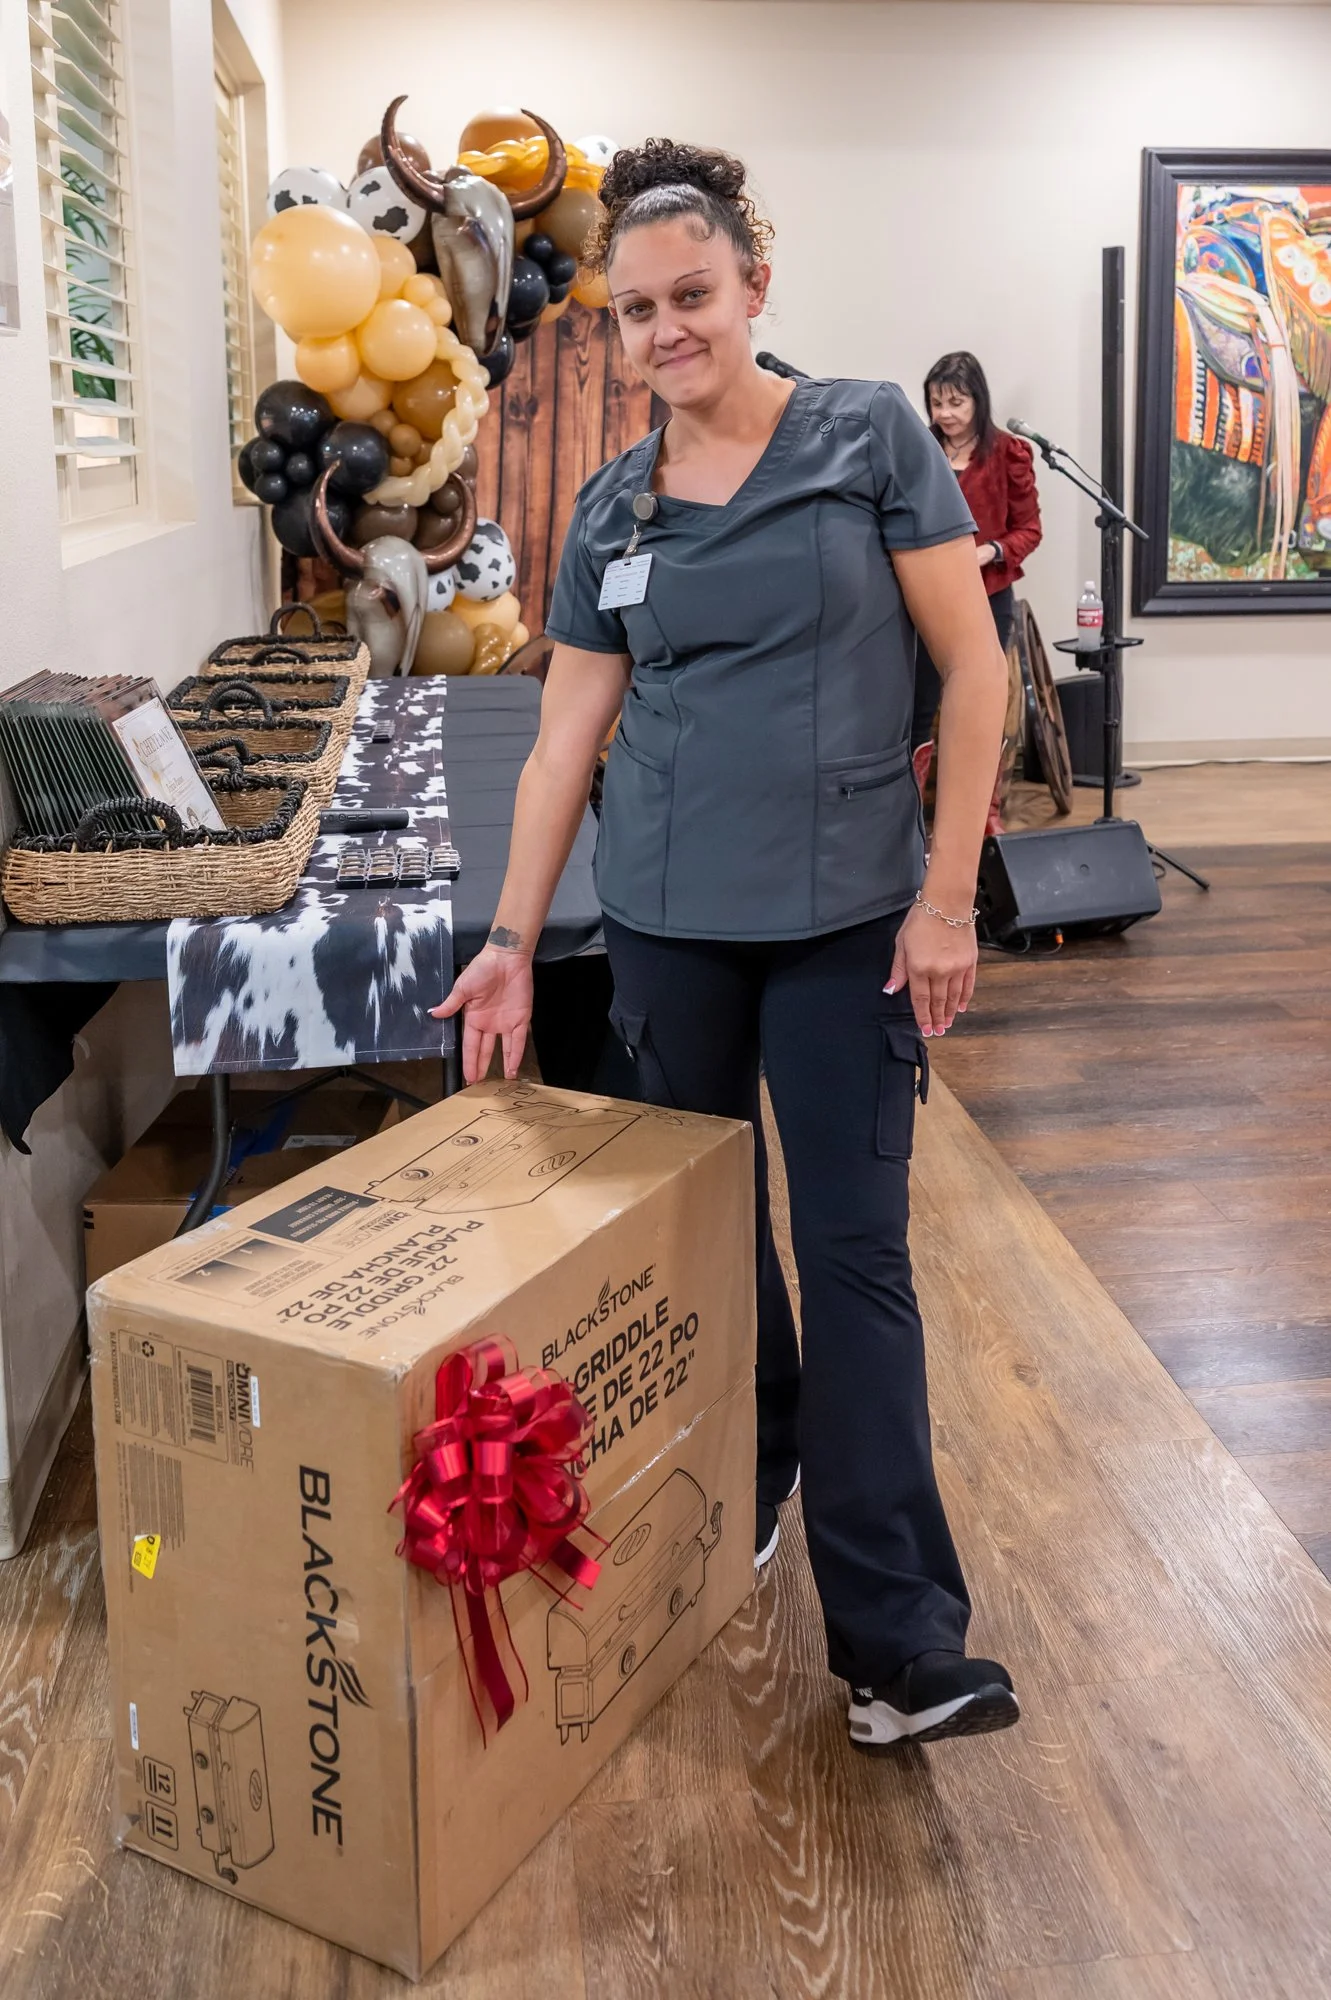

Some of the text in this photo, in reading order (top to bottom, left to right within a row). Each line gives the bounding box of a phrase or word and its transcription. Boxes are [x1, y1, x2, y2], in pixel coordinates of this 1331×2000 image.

[303, 1220, 485, 1324] PLAQUE DE 22 PO
[308, 1281, 348, 1301] DE
[341, 1224, 446, 1280] PLANCHA
[326, 1275, 424, 1331] GRIDDLE
[357, 1274, 464, 1339] BLACKSTONE
[542, 1264, 656, 1369] BLACKSTONE
[574, 1296, 669, 1395] GRIDDLE
[603, 1363, 633, 1413] DE
[639, 1339, 664, 1382] 22
[670, 1312, 699, 1356] PO
[629, 1380, 659, 1429] DE
[663, 1348, 695, 1399] 22"
[299, 1464, 344, 1846] BLACKSTONE
[158, 1773, 171, 1795] 12
